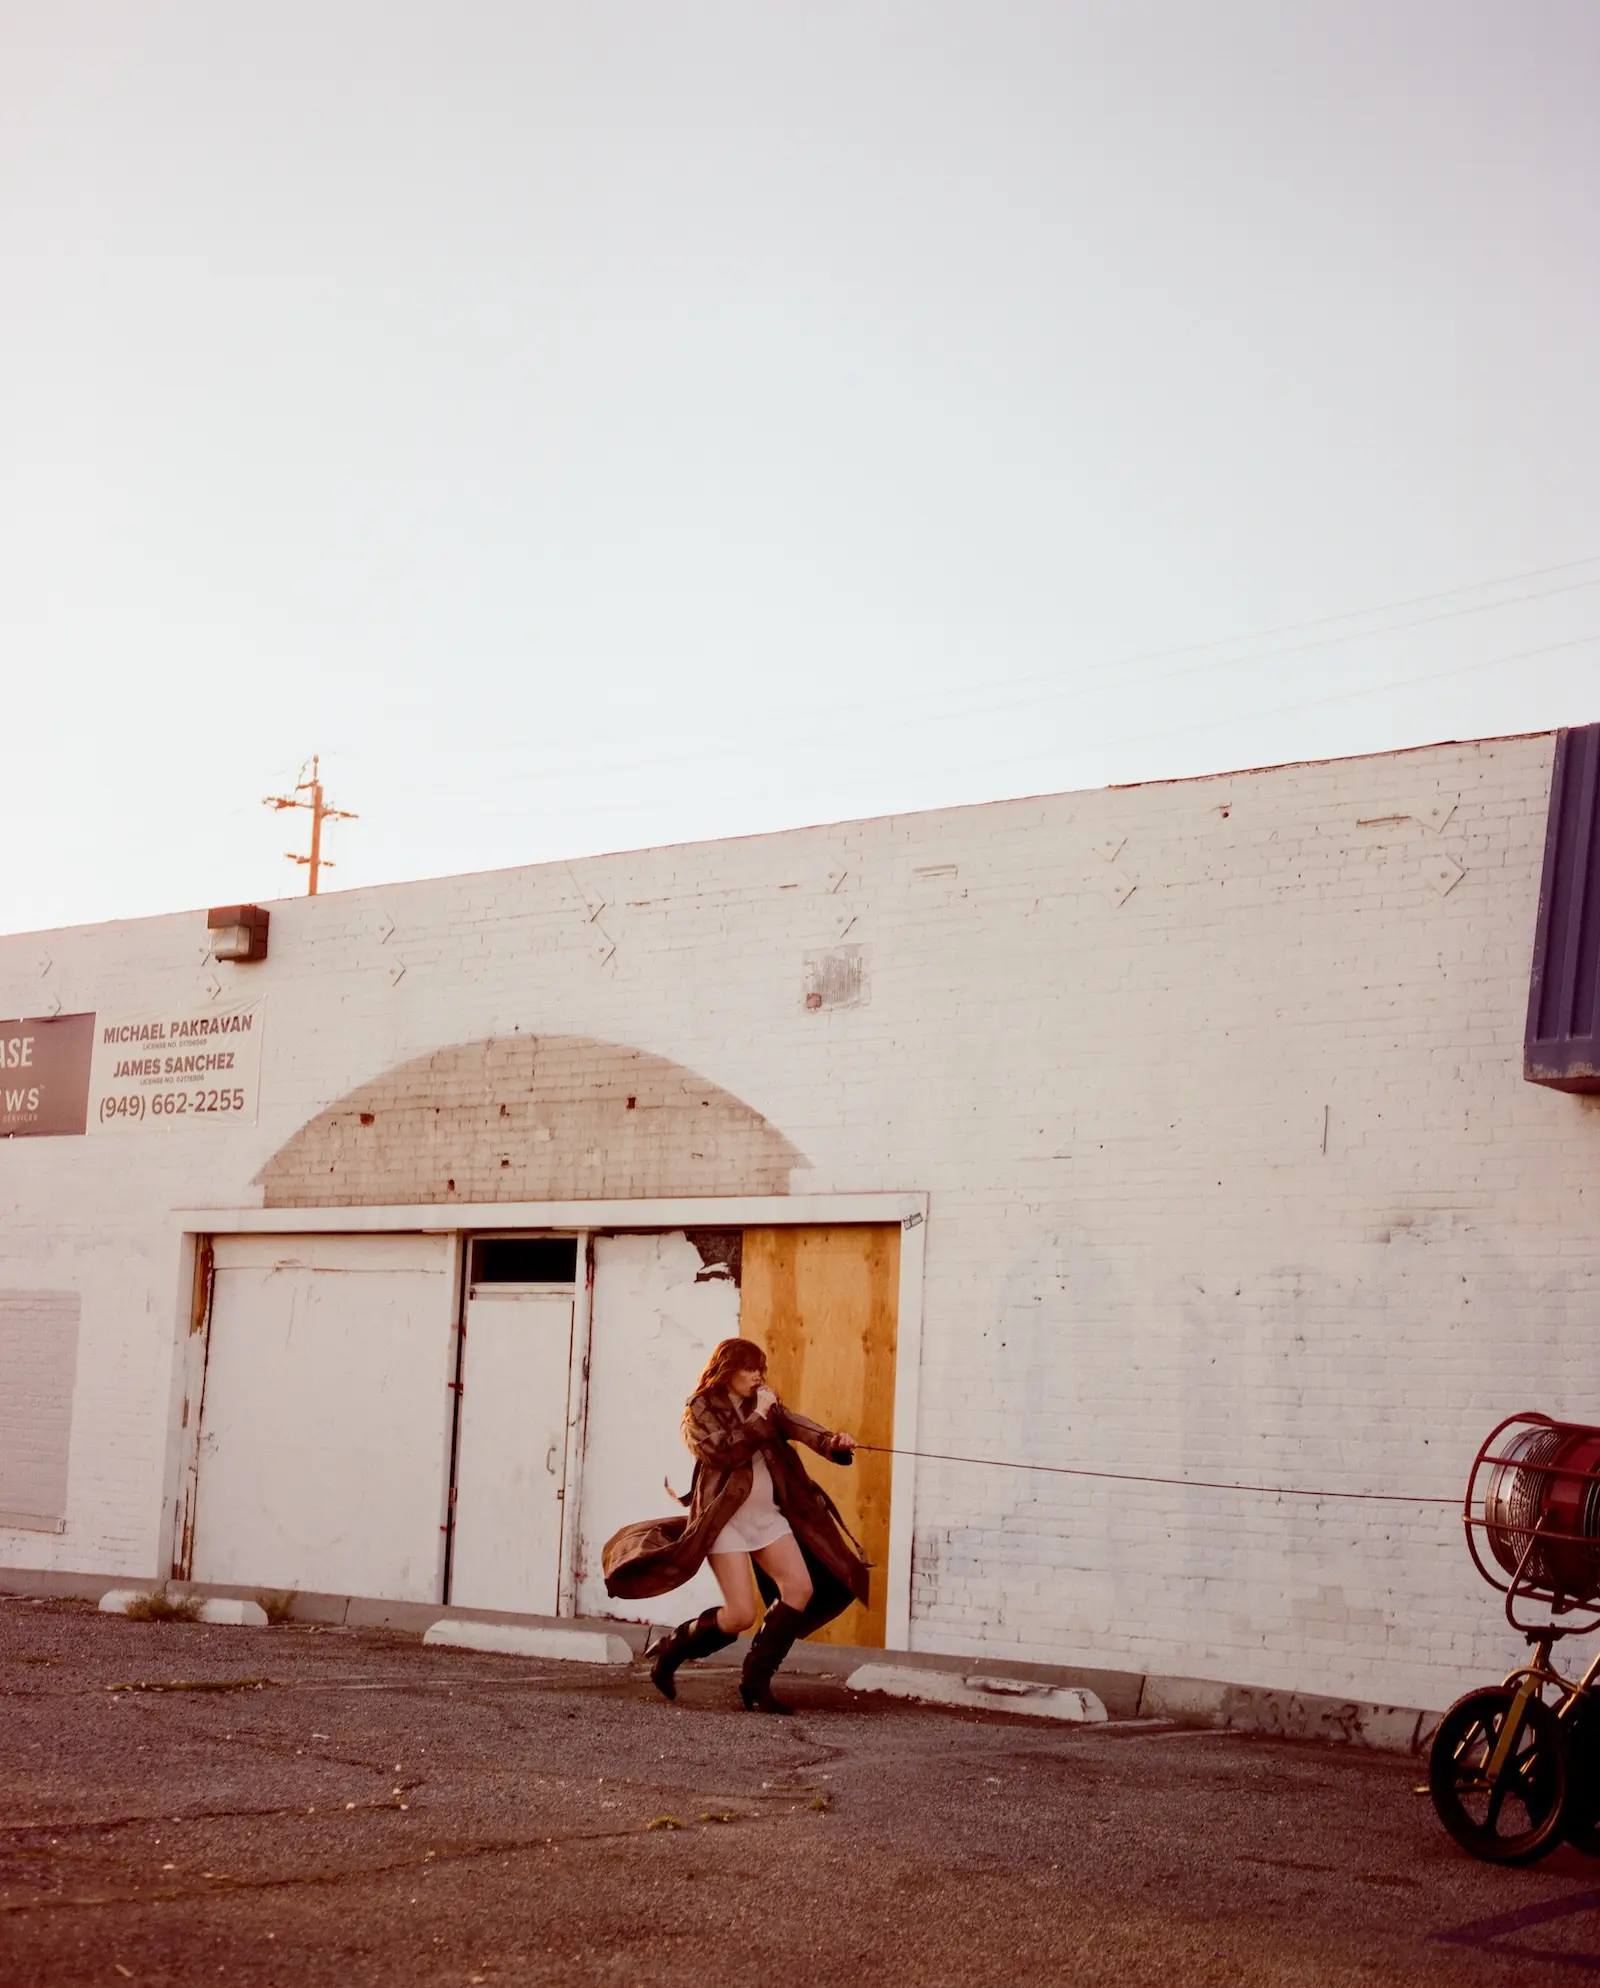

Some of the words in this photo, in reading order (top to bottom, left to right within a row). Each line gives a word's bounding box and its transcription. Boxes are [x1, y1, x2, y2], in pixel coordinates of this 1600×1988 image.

[103, 1023, 166, 1044] MICHAEL
[170, 1014, 253, 1039] PAKRAVAN
[113, 1058, 161, 1078] JAMES
[164, 1052, 235, 1074] SANCHEZ
[0, 1087, 39, 1112] WS
[99, 1095, 146, 1123] (949)
[151, 1088, 244, 1115] 662-2255
